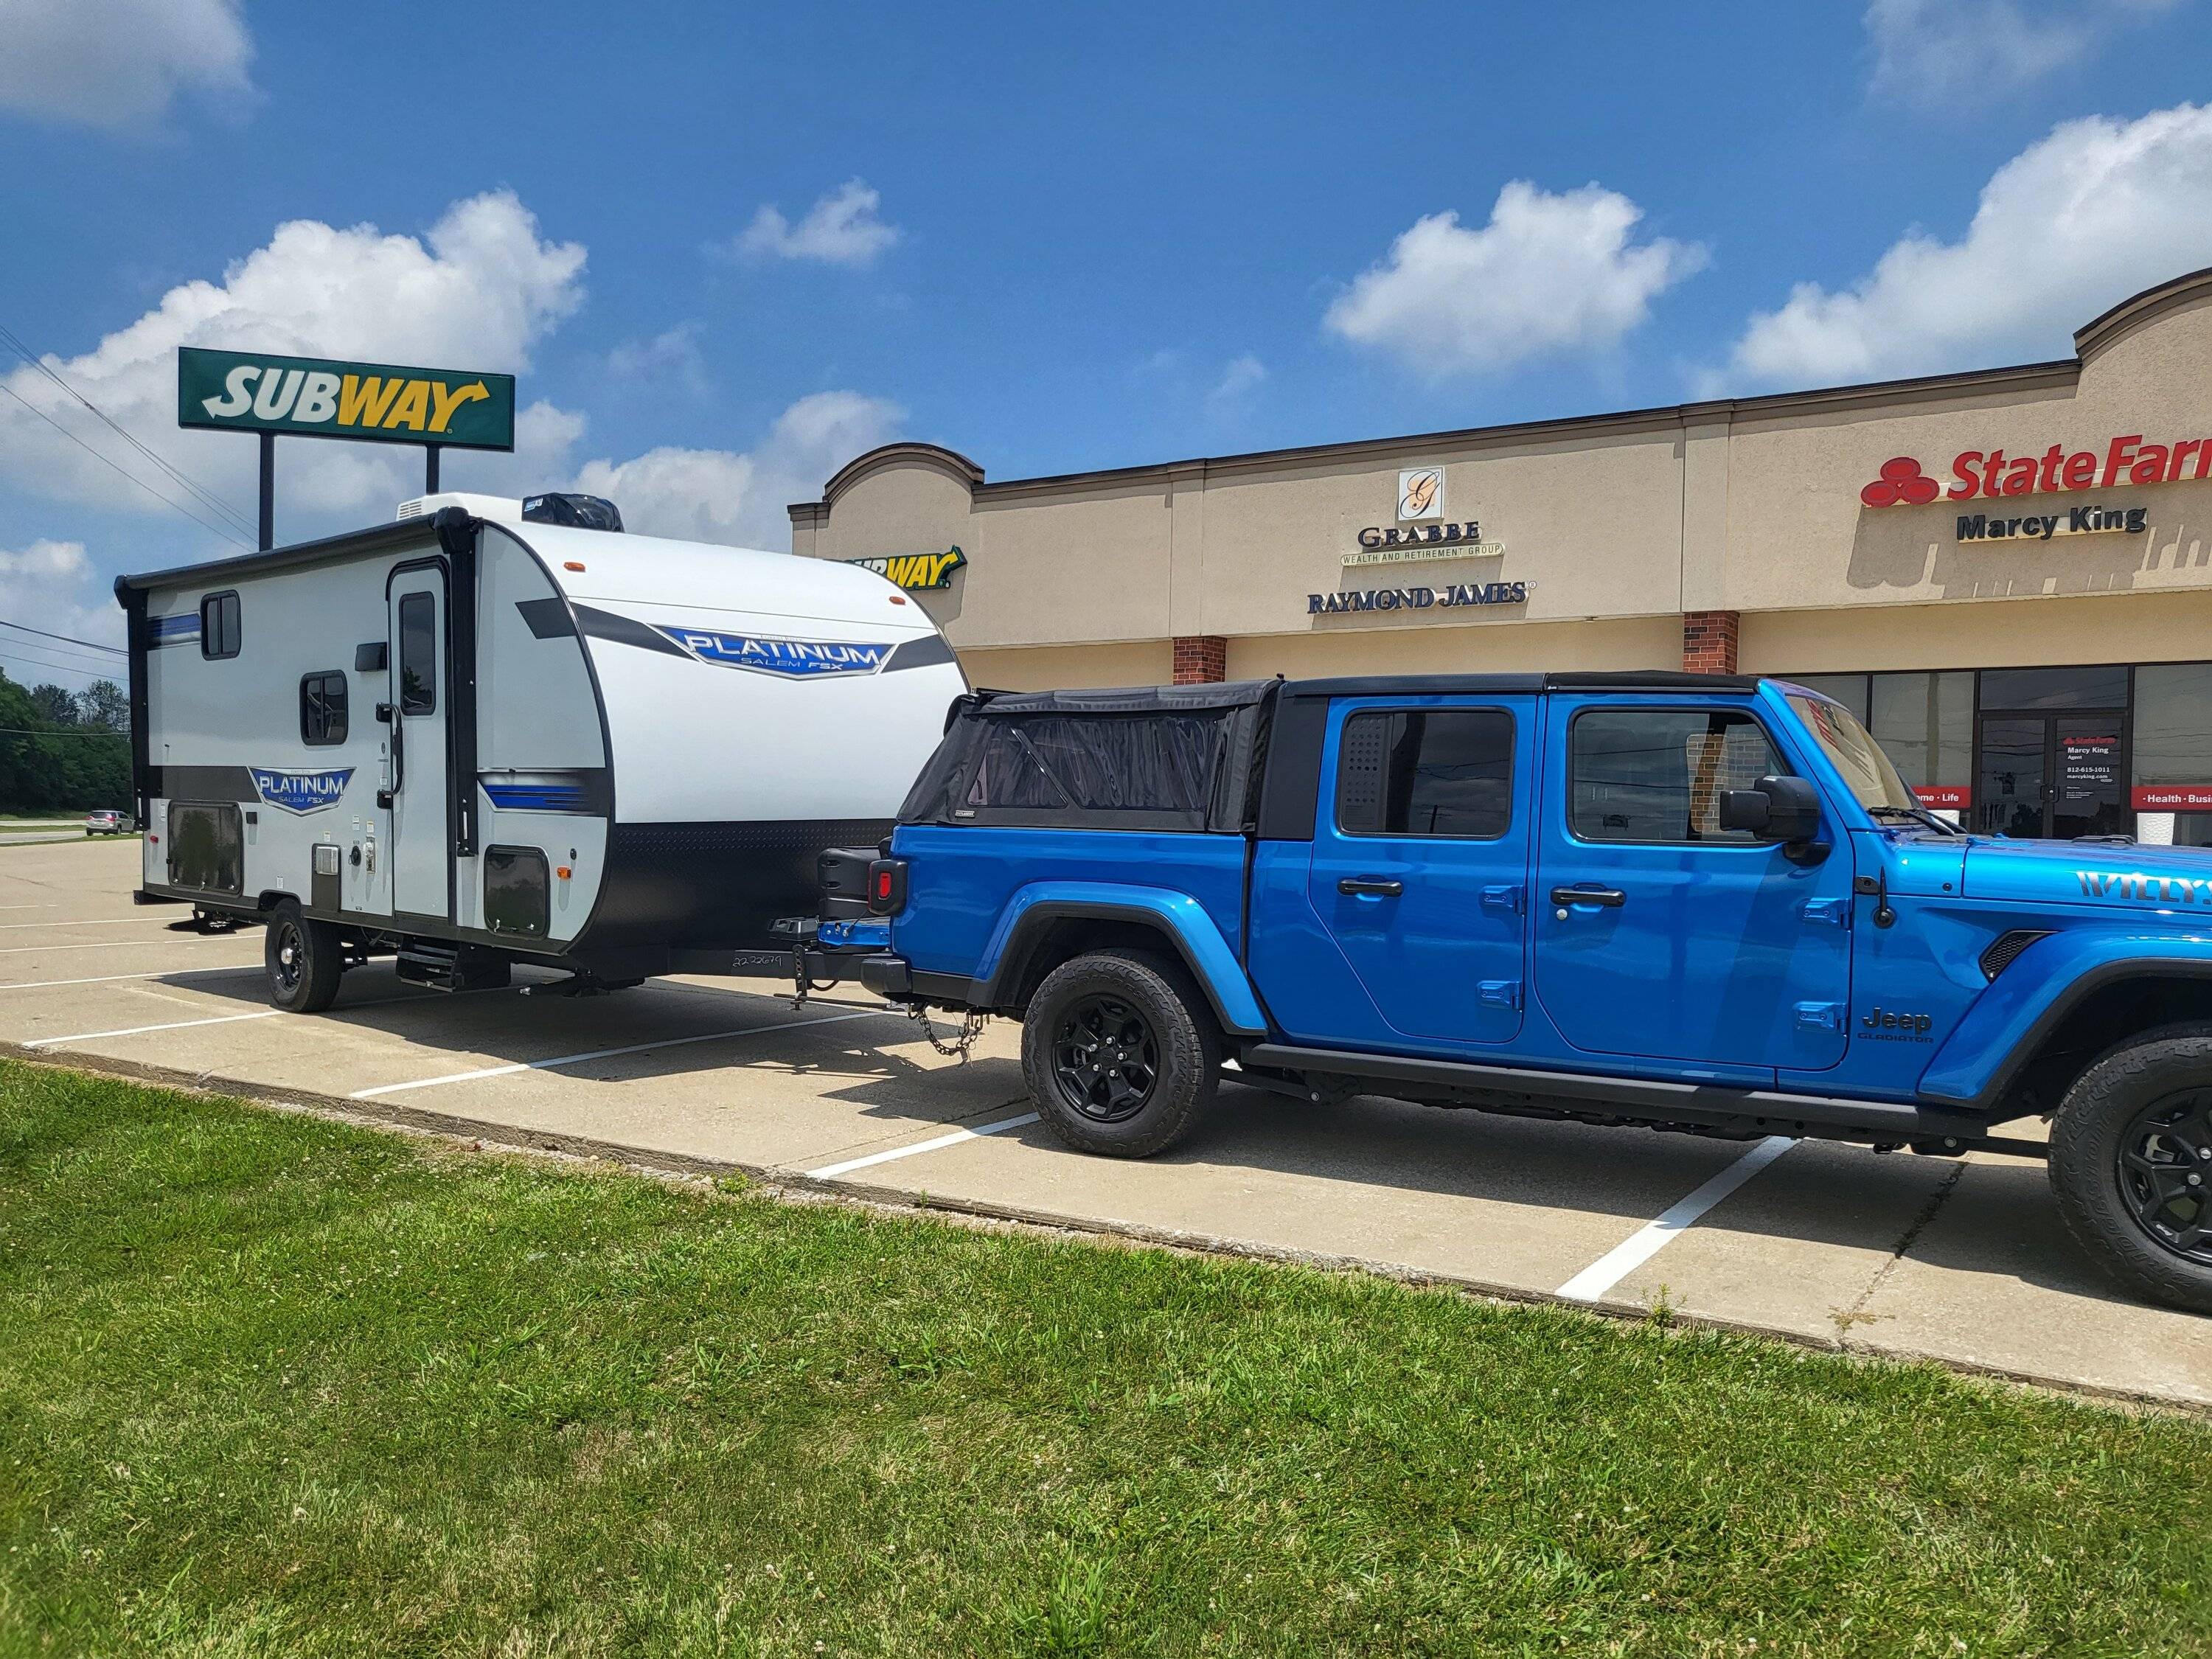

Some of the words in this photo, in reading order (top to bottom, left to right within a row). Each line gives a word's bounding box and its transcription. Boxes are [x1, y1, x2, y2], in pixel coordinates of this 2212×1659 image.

[201, 366, 490, 434] SUBWAY
[1947, 444, 2097, 501] State
[1357, 521, 1481, 548] GRABBE
[1956, 515, 2059, 540] Marcy
[2070, 506, 2147, 534] King
[1343, 554, 1378, 564] WEALTH
[1382, 552, 1400, 562] AND
[1405, 548, 1464, 560] RETIREMENT
[1468, 545, 1500, 555] GROUP
[1307, 588, 1435, 614] RAYMOND
[1439, 582, 1528, 608] JAMES
[684, 634, 880, 665] PLATINUM
[740, 657, 800, 667] SALEM
[808, 661, 844, 670] FSX
[2092, 746, 2110, 754] King
[260, 776, 344, 795] PLATINUM
[1942, 793, 1959, 801] Life
[2147, 794, 2182, 803] Health
[2188, 794, 2212, 803] Busi
[1862, 1007, 1933, 1035] Jeep
[1857, 1033, 1934, 1044] GLADIATOR
